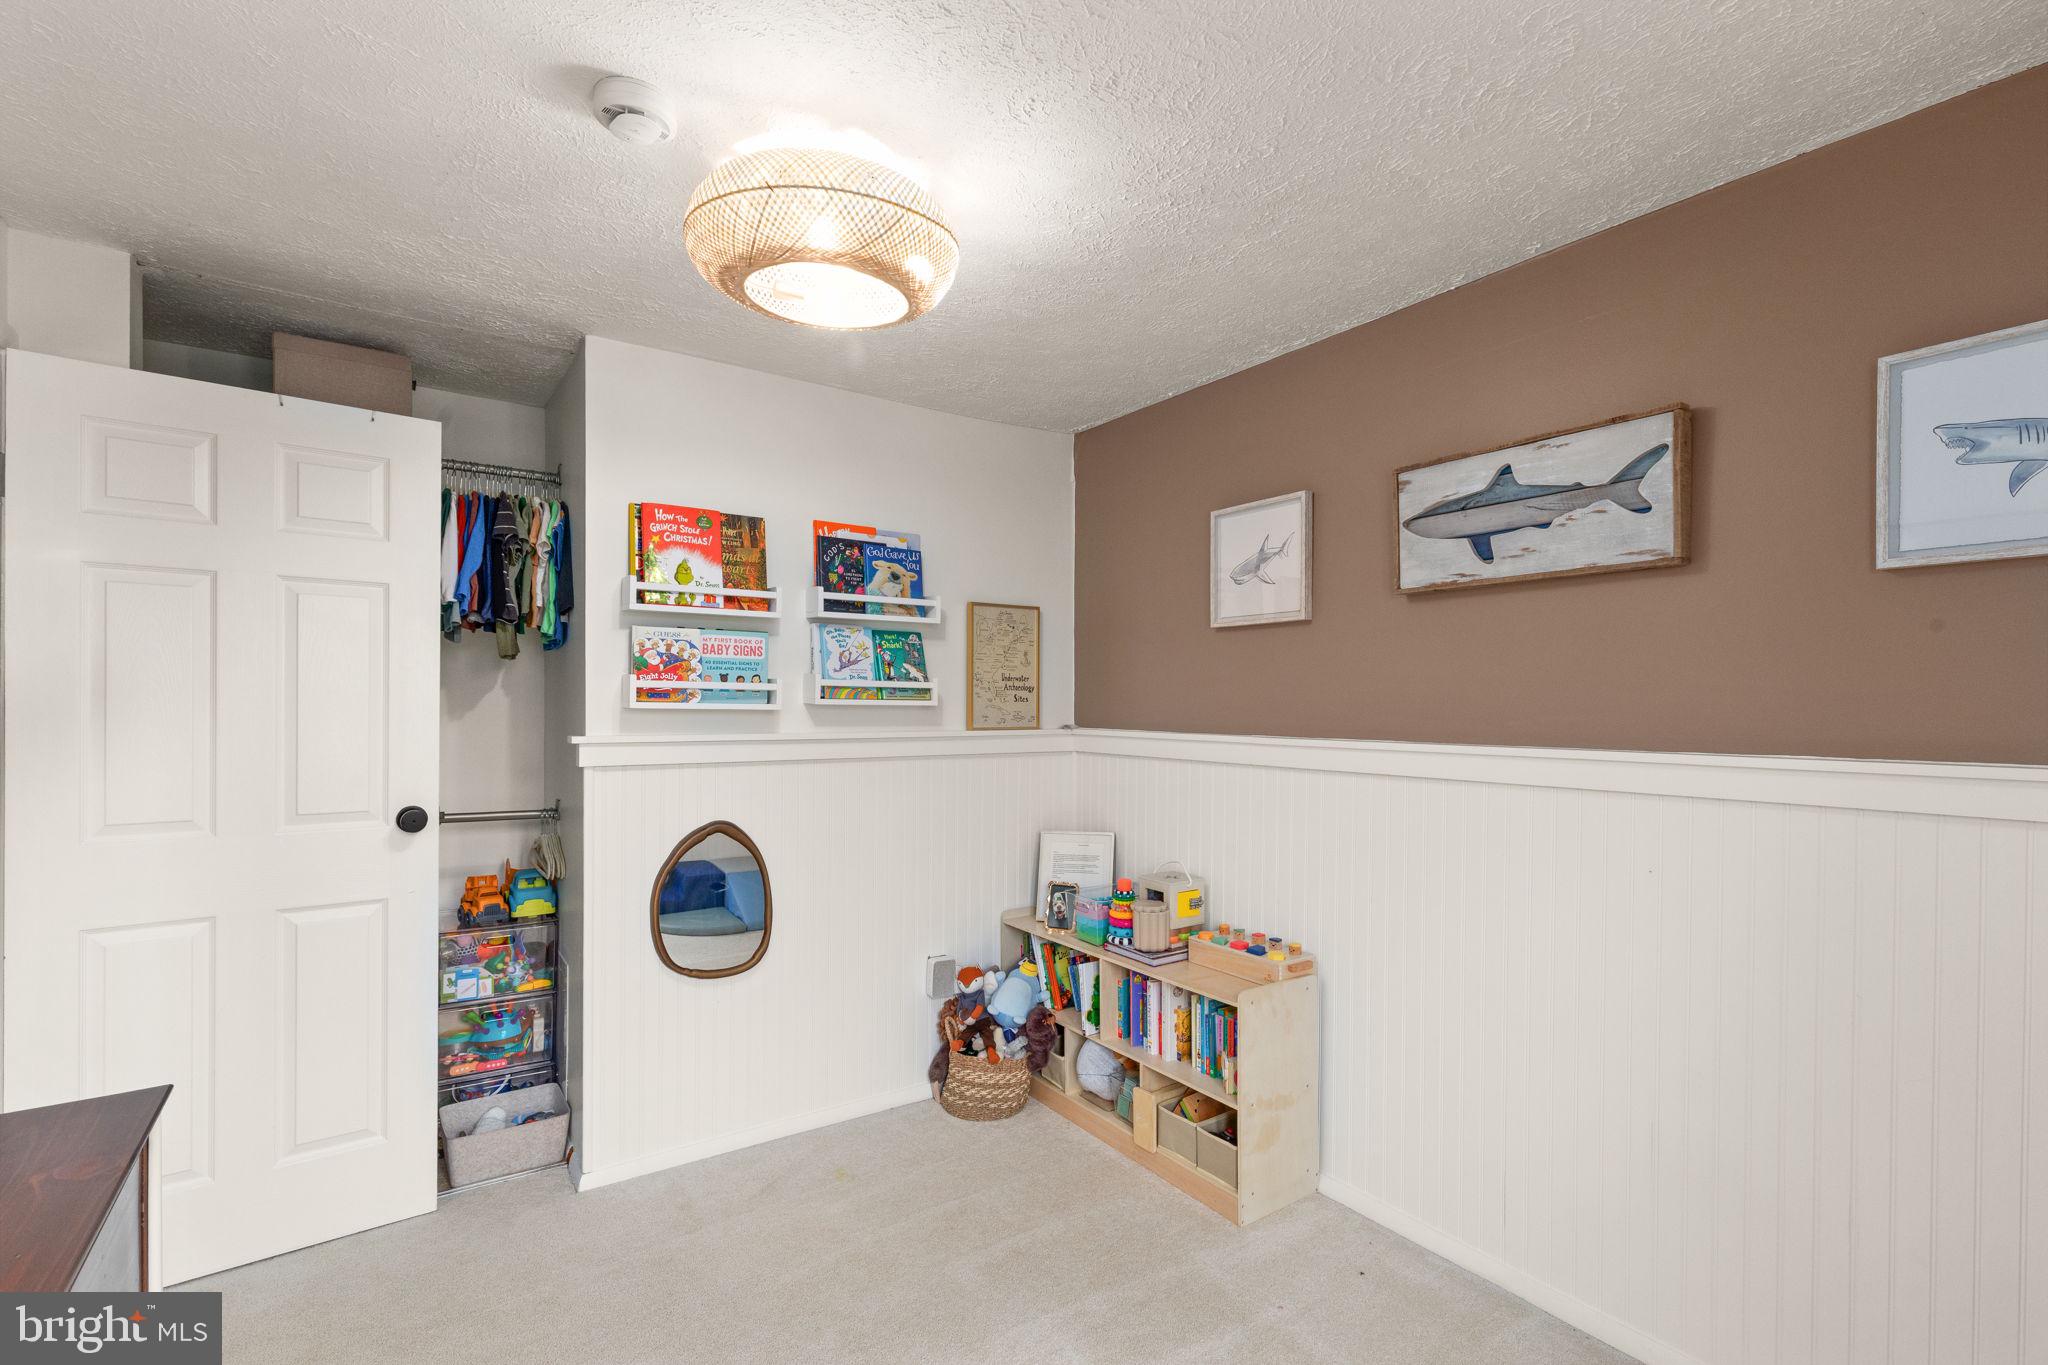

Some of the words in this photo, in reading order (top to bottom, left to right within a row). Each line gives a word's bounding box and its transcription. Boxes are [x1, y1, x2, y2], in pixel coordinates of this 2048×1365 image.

[650, 523, 677, 532] GRINCH
[679, 525, 701, 534] STOLE
[663, 532, 713, 546] CHRISTMAS!
[823, 542, 845, 562] GOD'S
[866, 546, 884, 557] God
[884, 548, 906, 560] Gave
[902, 558, 920, 571] You
[695, 580, 703, 588] Dr.
[701, 643, 731, 656] BABY
[733, 645, 763, 657] SIGNS
[881, 640, 903, 649] Shark!
[660, 672, 678, 681] Jolly
[1001, 673, 1030, 682] Underwater
[1003, 681, 1035, 693] Archaeology
[1013, 694, 1029, 703] Sites
